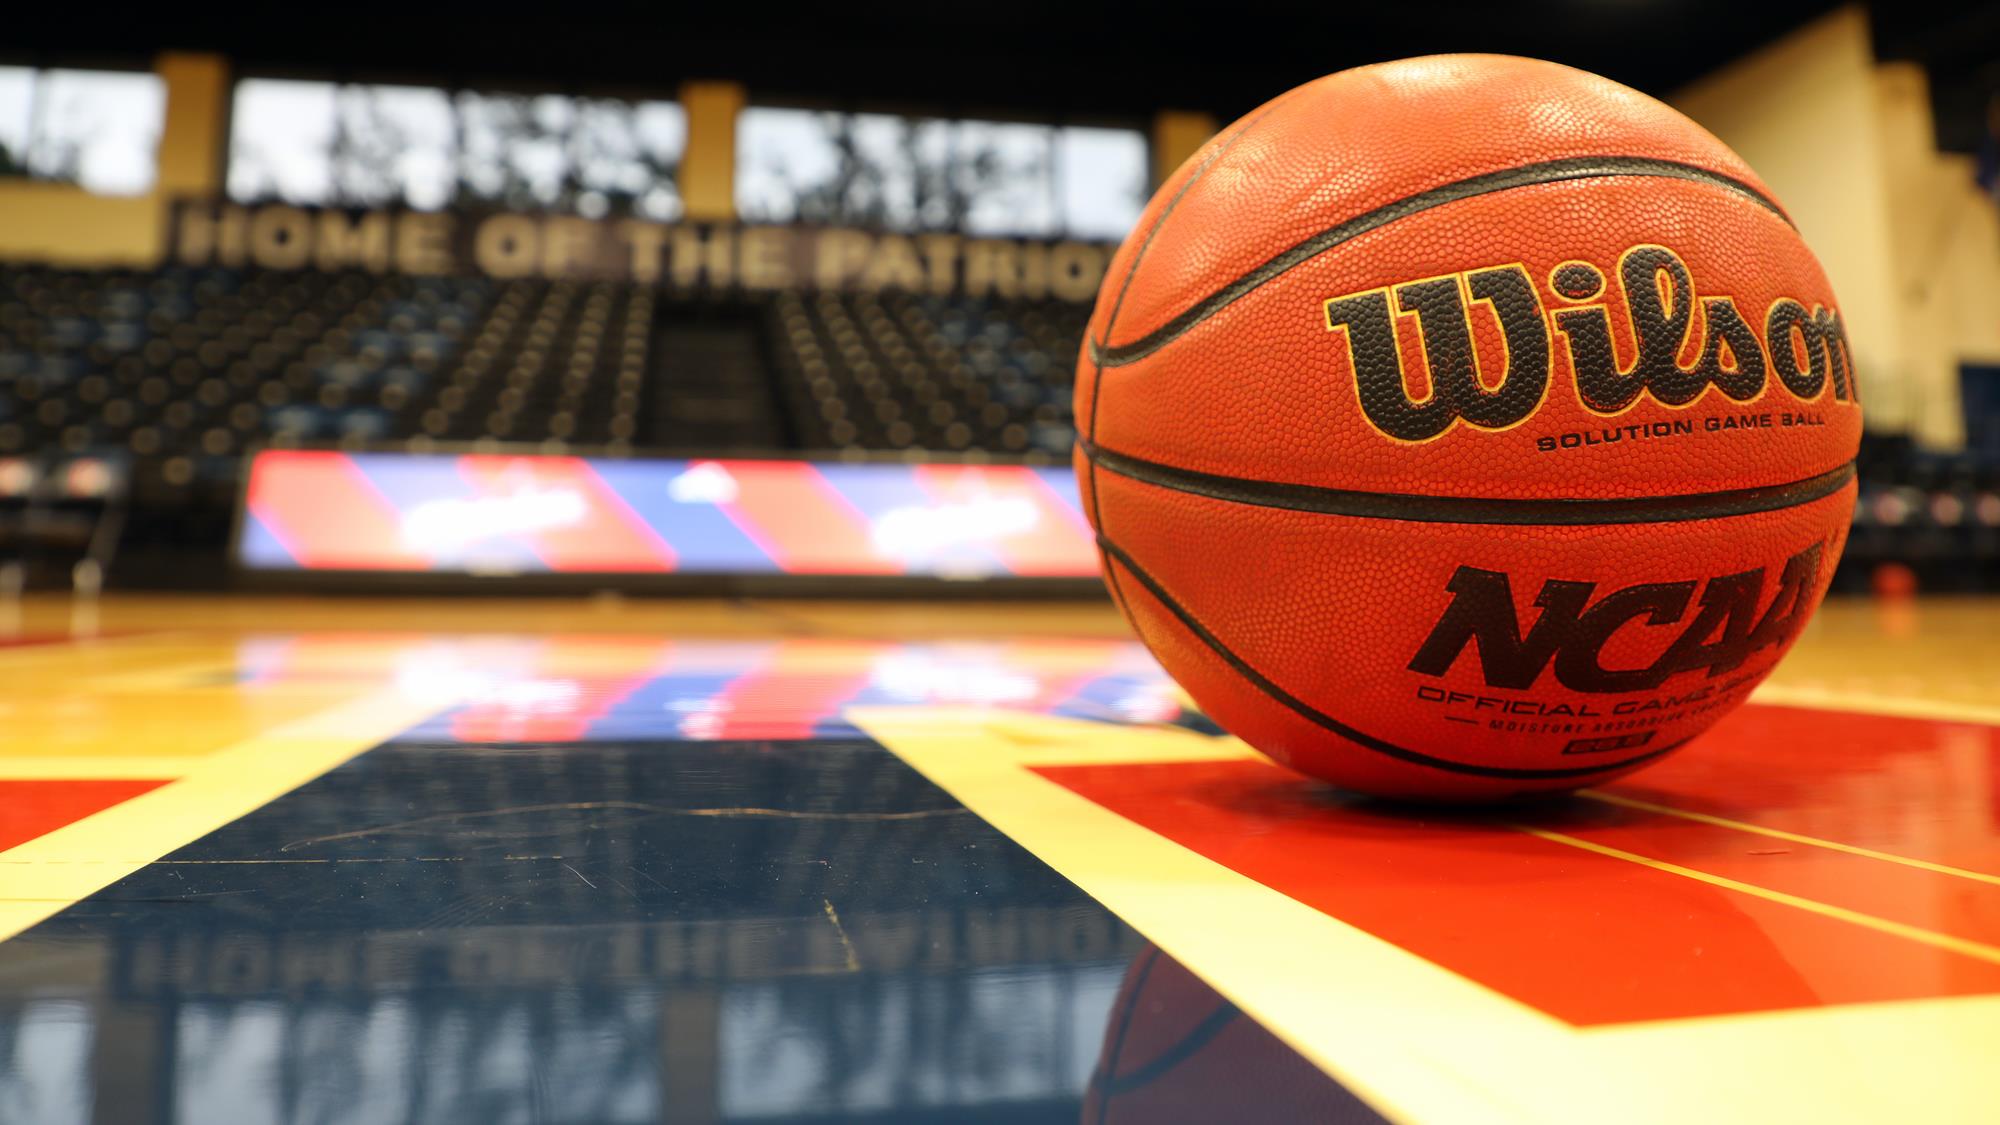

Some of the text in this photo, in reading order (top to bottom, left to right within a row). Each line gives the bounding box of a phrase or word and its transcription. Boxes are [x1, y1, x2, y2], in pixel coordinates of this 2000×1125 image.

[178, 207, 1114, 302] HOME OF THE PATRIO
[1324, 243, 1859, 446] Wilson
[1536, 412, 1825, 453] SOLUTION GAME BALL
[1406, 539, 1823, 694] NCAA
[1417, 685, 1600, 717] OFFICIAL
